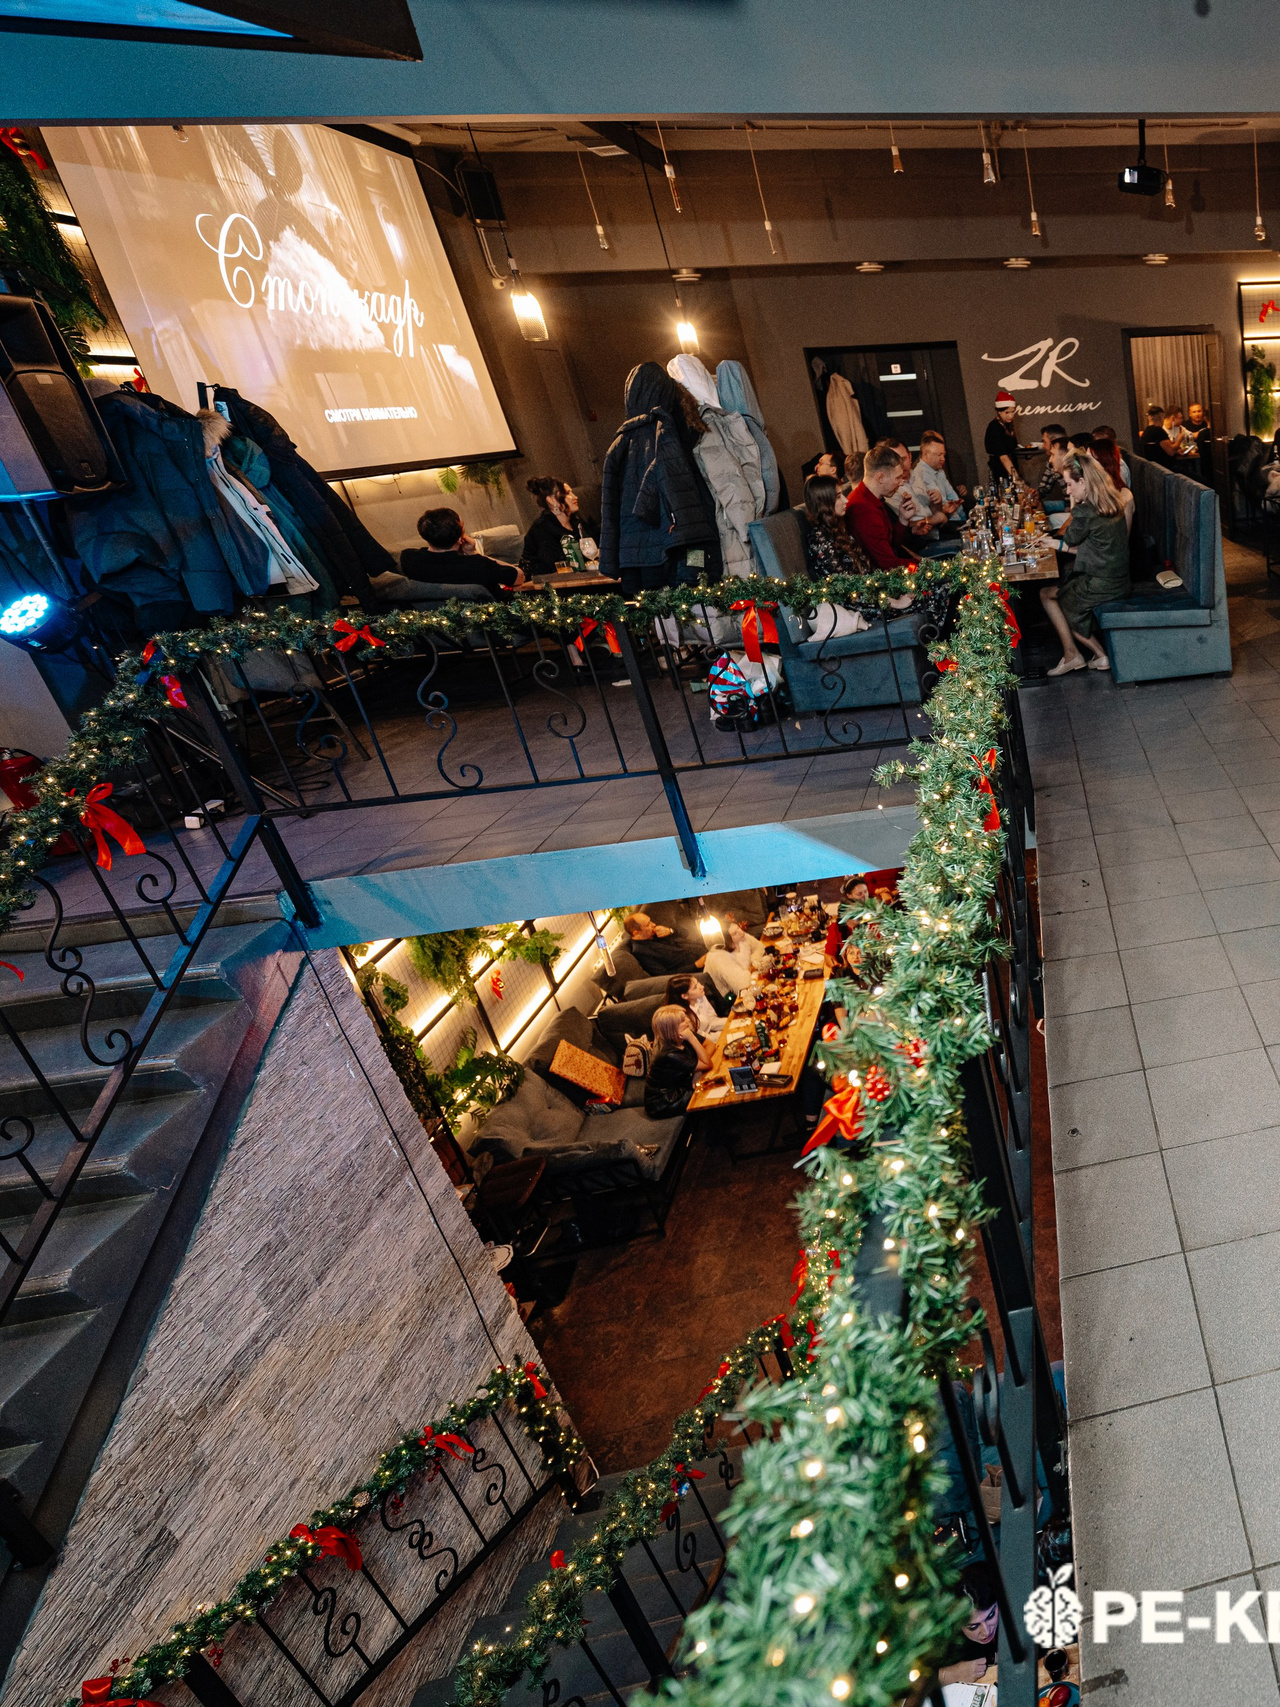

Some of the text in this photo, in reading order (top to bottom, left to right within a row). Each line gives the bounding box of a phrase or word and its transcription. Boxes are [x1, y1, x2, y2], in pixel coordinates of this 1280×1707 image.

[981, 337, 1091, 391] ZR
[324, 406, 418, 423] СМОТРИ ВНИМАТЕЛЬНО
[1013, 401, 1102, 416] remium
